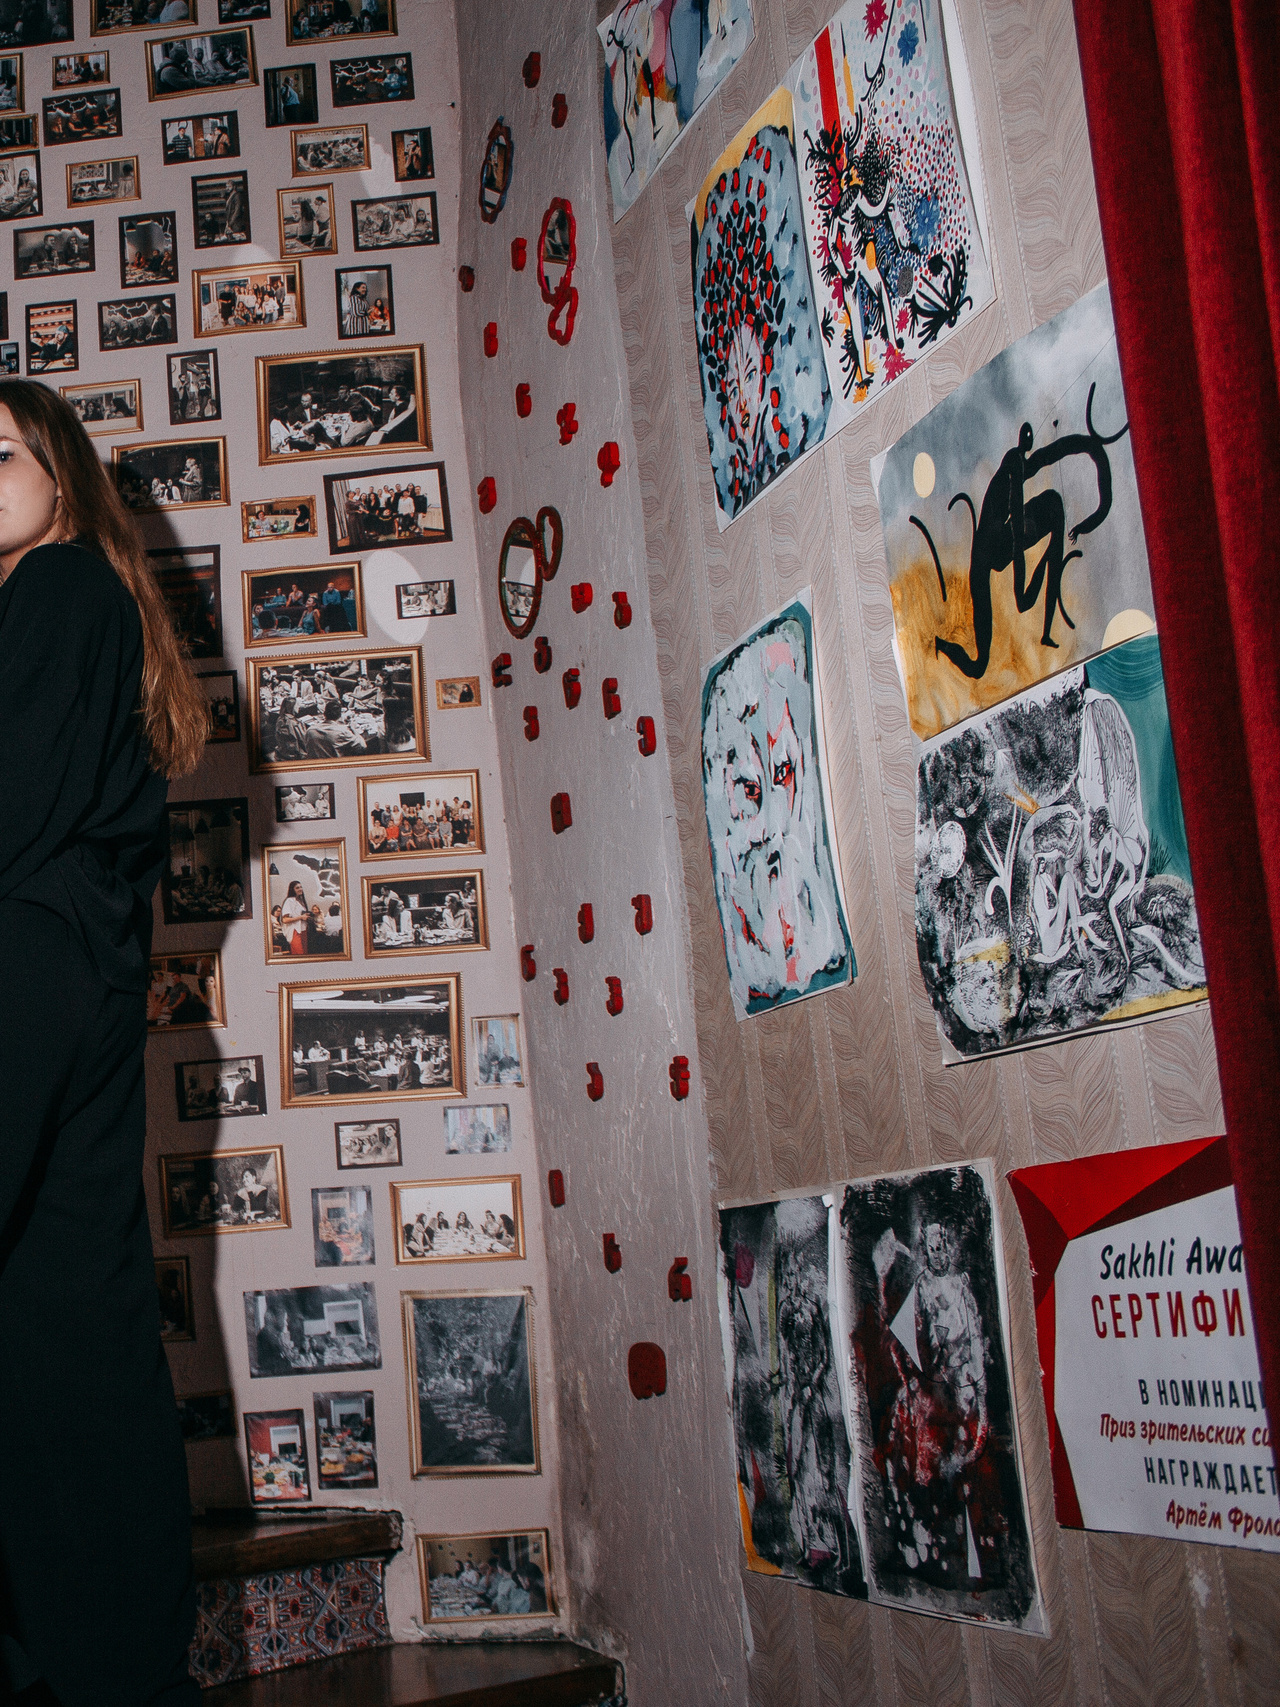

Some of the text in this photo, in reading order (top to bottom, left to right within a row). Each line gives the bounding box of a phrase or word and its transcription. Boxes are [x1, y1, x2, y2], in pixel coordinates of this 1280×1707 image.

[1100, 1236, 1243, 1280] Sakhli Awa
[1091, 1288, 1245, 1339] СЕРТИФИ
[1138, 1379, 1150, 1405] В
[1100, 1413, 1135, 1443] Приз
[1140, 1419, 1246, 1446] зрительских
[1144, 1456, 1276, 1495] НАГРАЖДАЕТ
[1166, 1499, 1222, 1530] Артём
